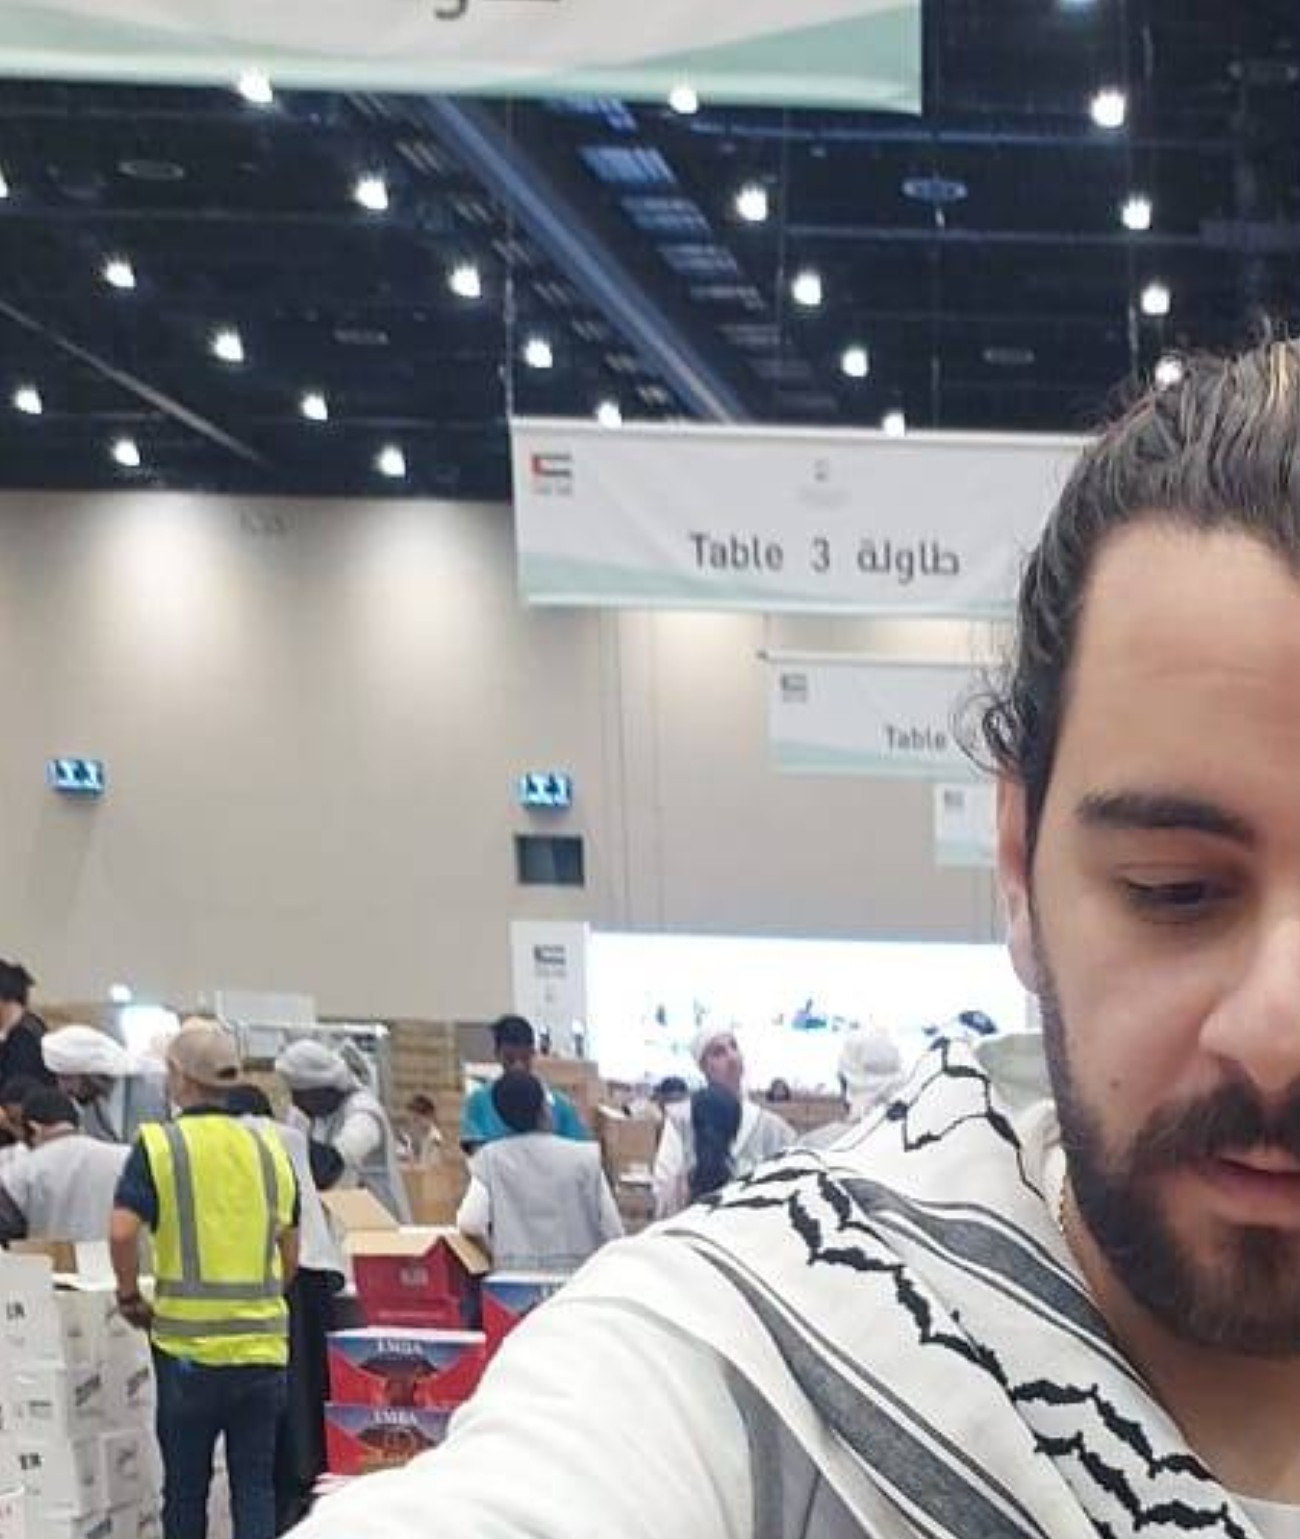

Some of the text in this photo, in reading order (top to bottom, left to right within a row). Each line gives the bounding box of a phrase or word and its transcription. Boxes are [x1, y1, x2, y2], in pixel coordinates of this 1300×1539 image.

[690, 533, 831, 571] Table 3
[857, 540, 961, 584] طاولة
[886, 723, 947, 751] Table
